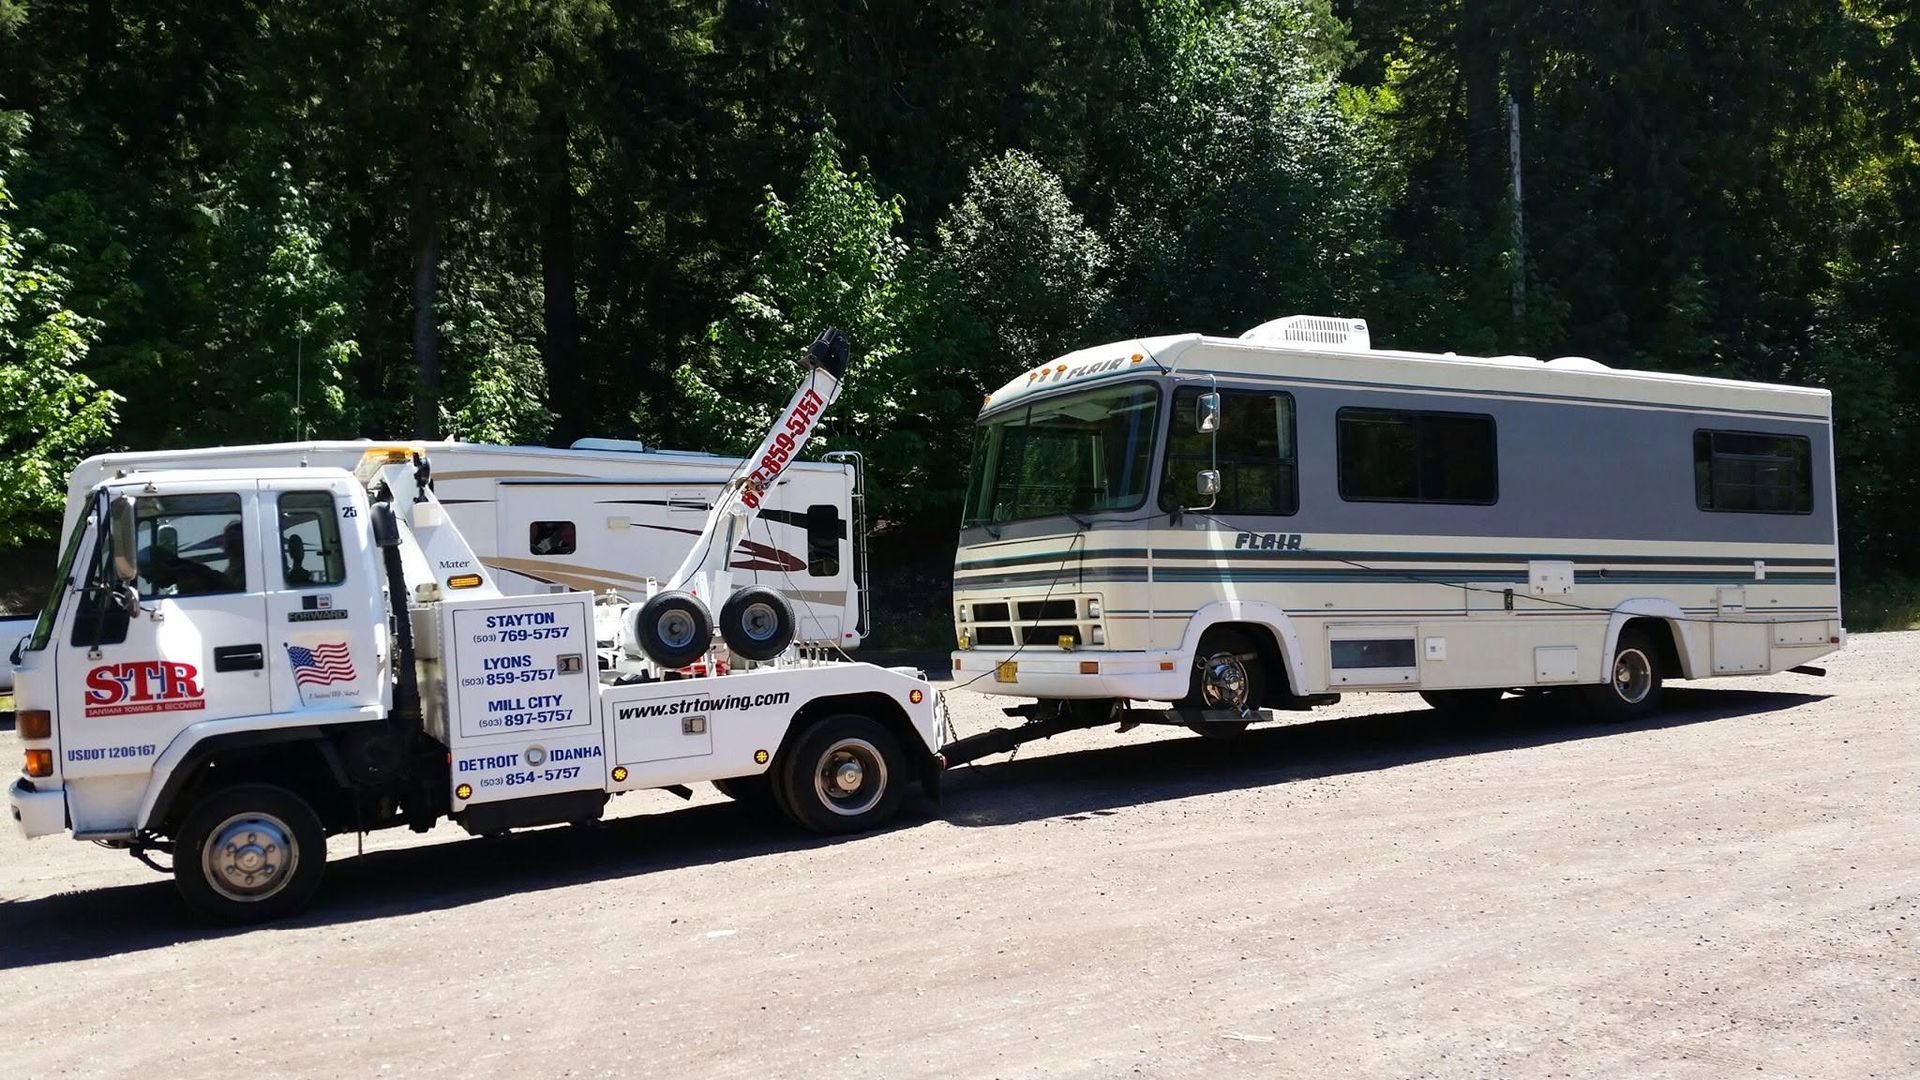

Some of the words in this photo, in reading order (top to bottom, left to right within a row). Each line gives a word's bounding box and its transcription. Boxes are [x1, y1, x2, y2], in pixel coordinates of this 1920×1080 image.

[1067, 357, 1125, 379] FLAIR
[342, 506, 358, 518] 25
[1235, 533, 1302, 550] FLAIR
[439, 560, 471, 570] Mater
[289, 609, 347, 621] FORWARD
[486, 612, 555, 628] STAYTON
[473, 634, 496, 643] (503)
[498, 627, 569, 643] 769-5757
[484, 655, 532, 671] LYONS
[85, 661, 204, 705] STR
[462, 677, 484, 687] (503)
[486, 669, 555, 686] 859-5757
[89, 707, 121, 716] SANTIAM
[125, 705, 153, 714] TOWING
[165, 701, 203, 711] RECOVERY
[488, 698, 525, 712] MILL
[528, 694, 563, 710] CITY
[619, 692, 790, 720] www.strtowing.com
[479, 719, 502, 728] (503)
[504, 709, 573, 727] 897-5757
[68, 748, 106, 762] USDOT
[109, 745, 156, 758] 1206167
[459, 754, 519, 772] DETROIT
[550, 746, 602, 762] IDANHA
[480, 778, 503, 788] (503)
